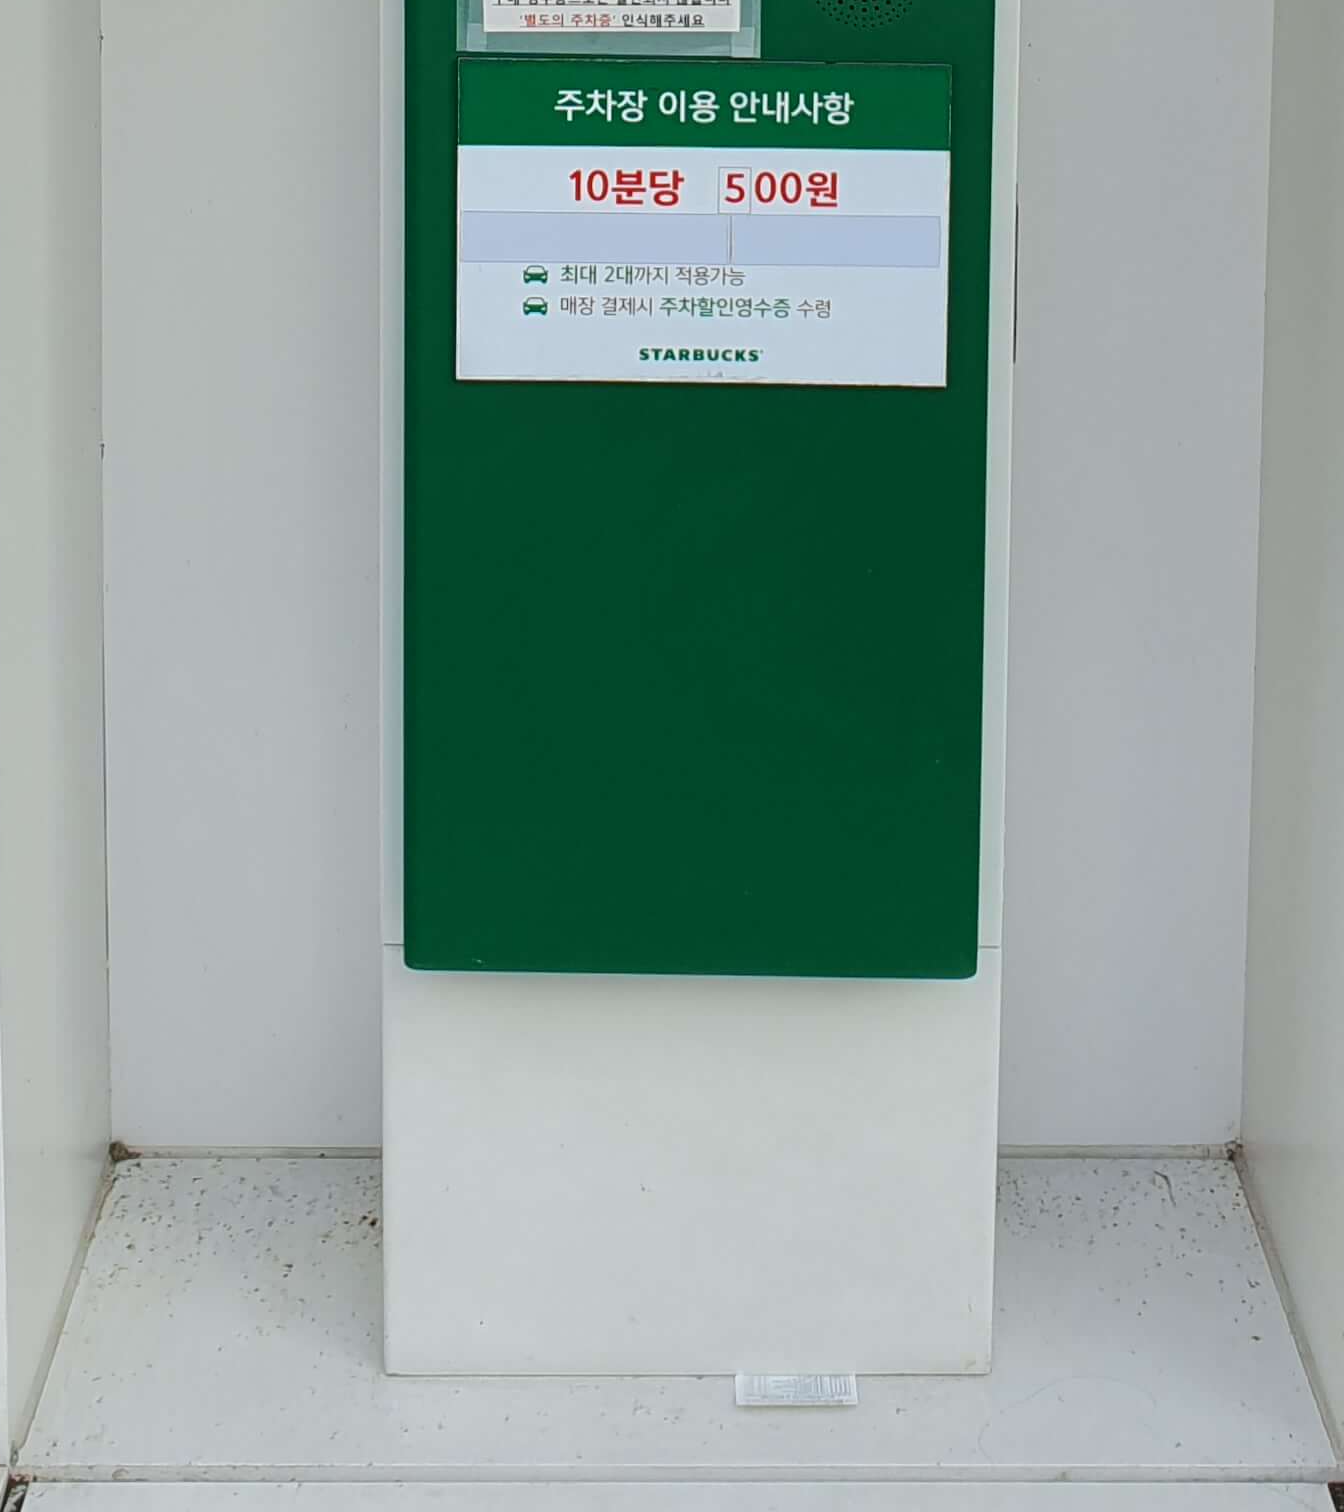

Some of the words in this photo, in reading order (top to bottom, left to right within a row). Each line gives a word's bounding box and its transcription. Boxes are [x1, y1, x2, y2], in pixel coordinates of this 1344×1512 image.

[622, 14, 704, 26] 인식해주세요
[554, 90, 648, 122] 주차장
[659, 91, 720, 123] 이용
[730, 91, 854, 125] 안내사항
[570, 170, 684, 206] 10분당
[724, 169, 839, 207] 500원
[561, 266, 597, 284] 최대
[604, 266, 668, 285] 2대까지
[675, 263, 745, 286] 적용가능
[561, 296, 595, 315] 매장
[602, 297, 652, 315] 결제시
[660, 297, 791, 318] 주차할인영수증
[797, 300, 832, 318] 수령
[640, 349, 762, 362] STARBUCKS
